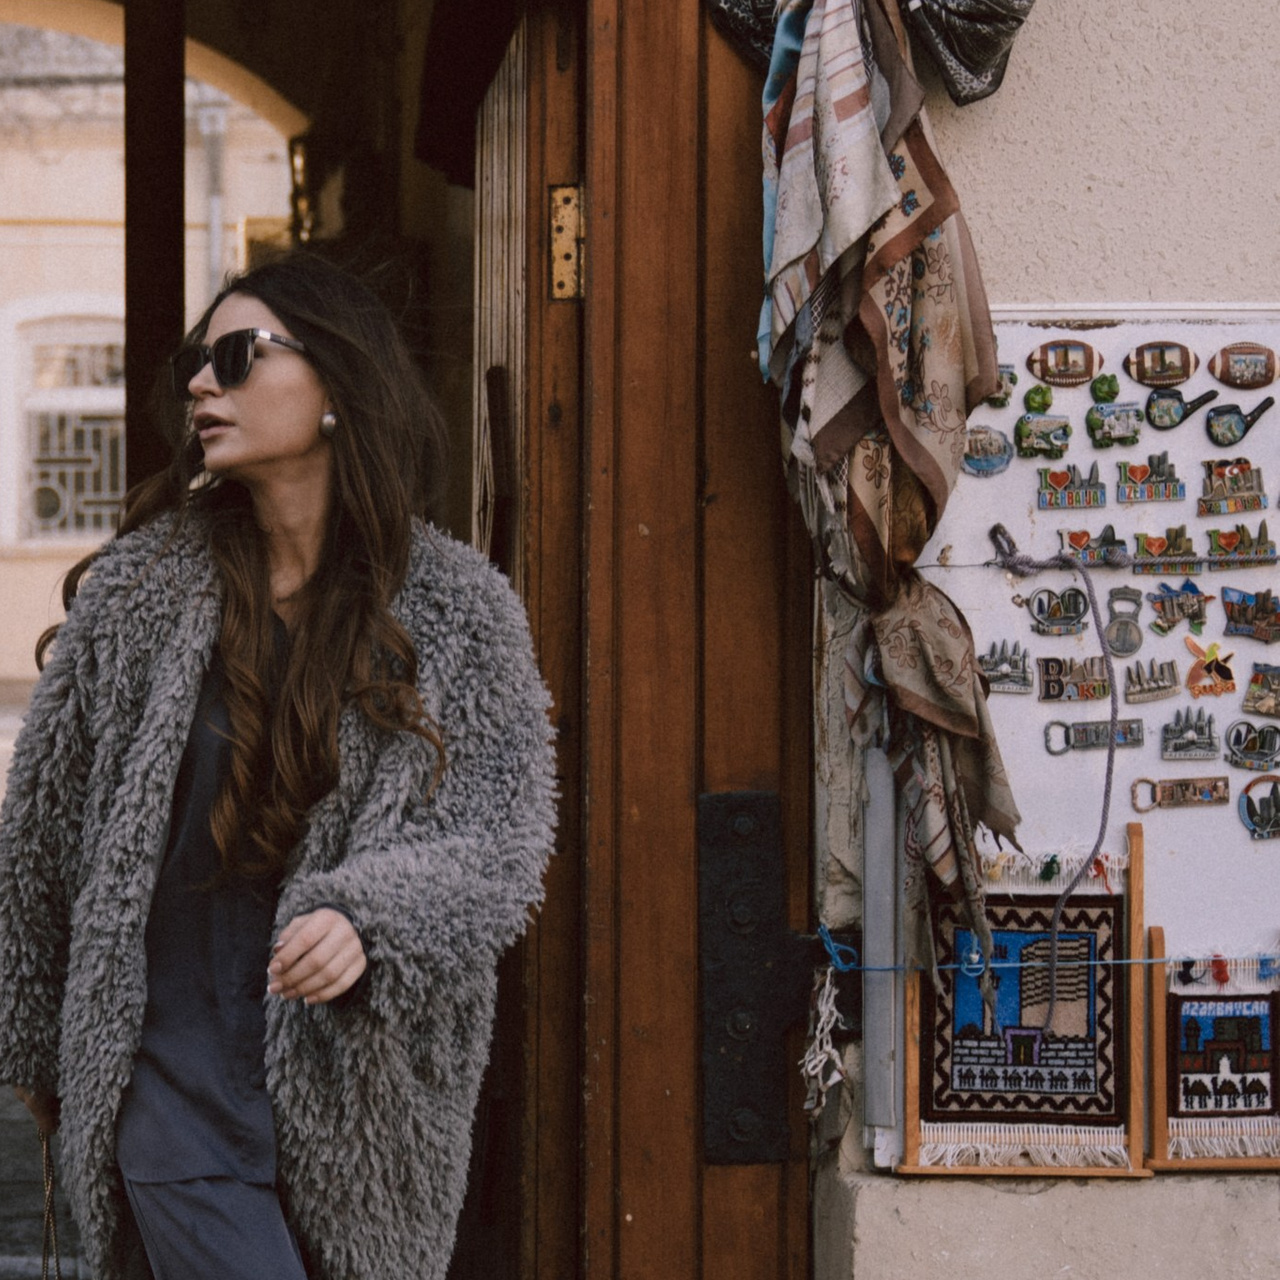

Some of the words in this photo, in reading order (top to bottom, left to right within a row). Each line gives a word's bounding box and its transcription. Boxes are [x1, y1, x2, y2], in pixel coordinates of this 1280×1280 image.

[1038, 468, 1051, 490] I
[1116, 461, 1130, 484] I
[1040, 490, 1106, 508] AZERBAIJAN
[1119, 483, 1186, 502] AZERBAIJAN
[1038, 658, 1111, 701] BAKU
